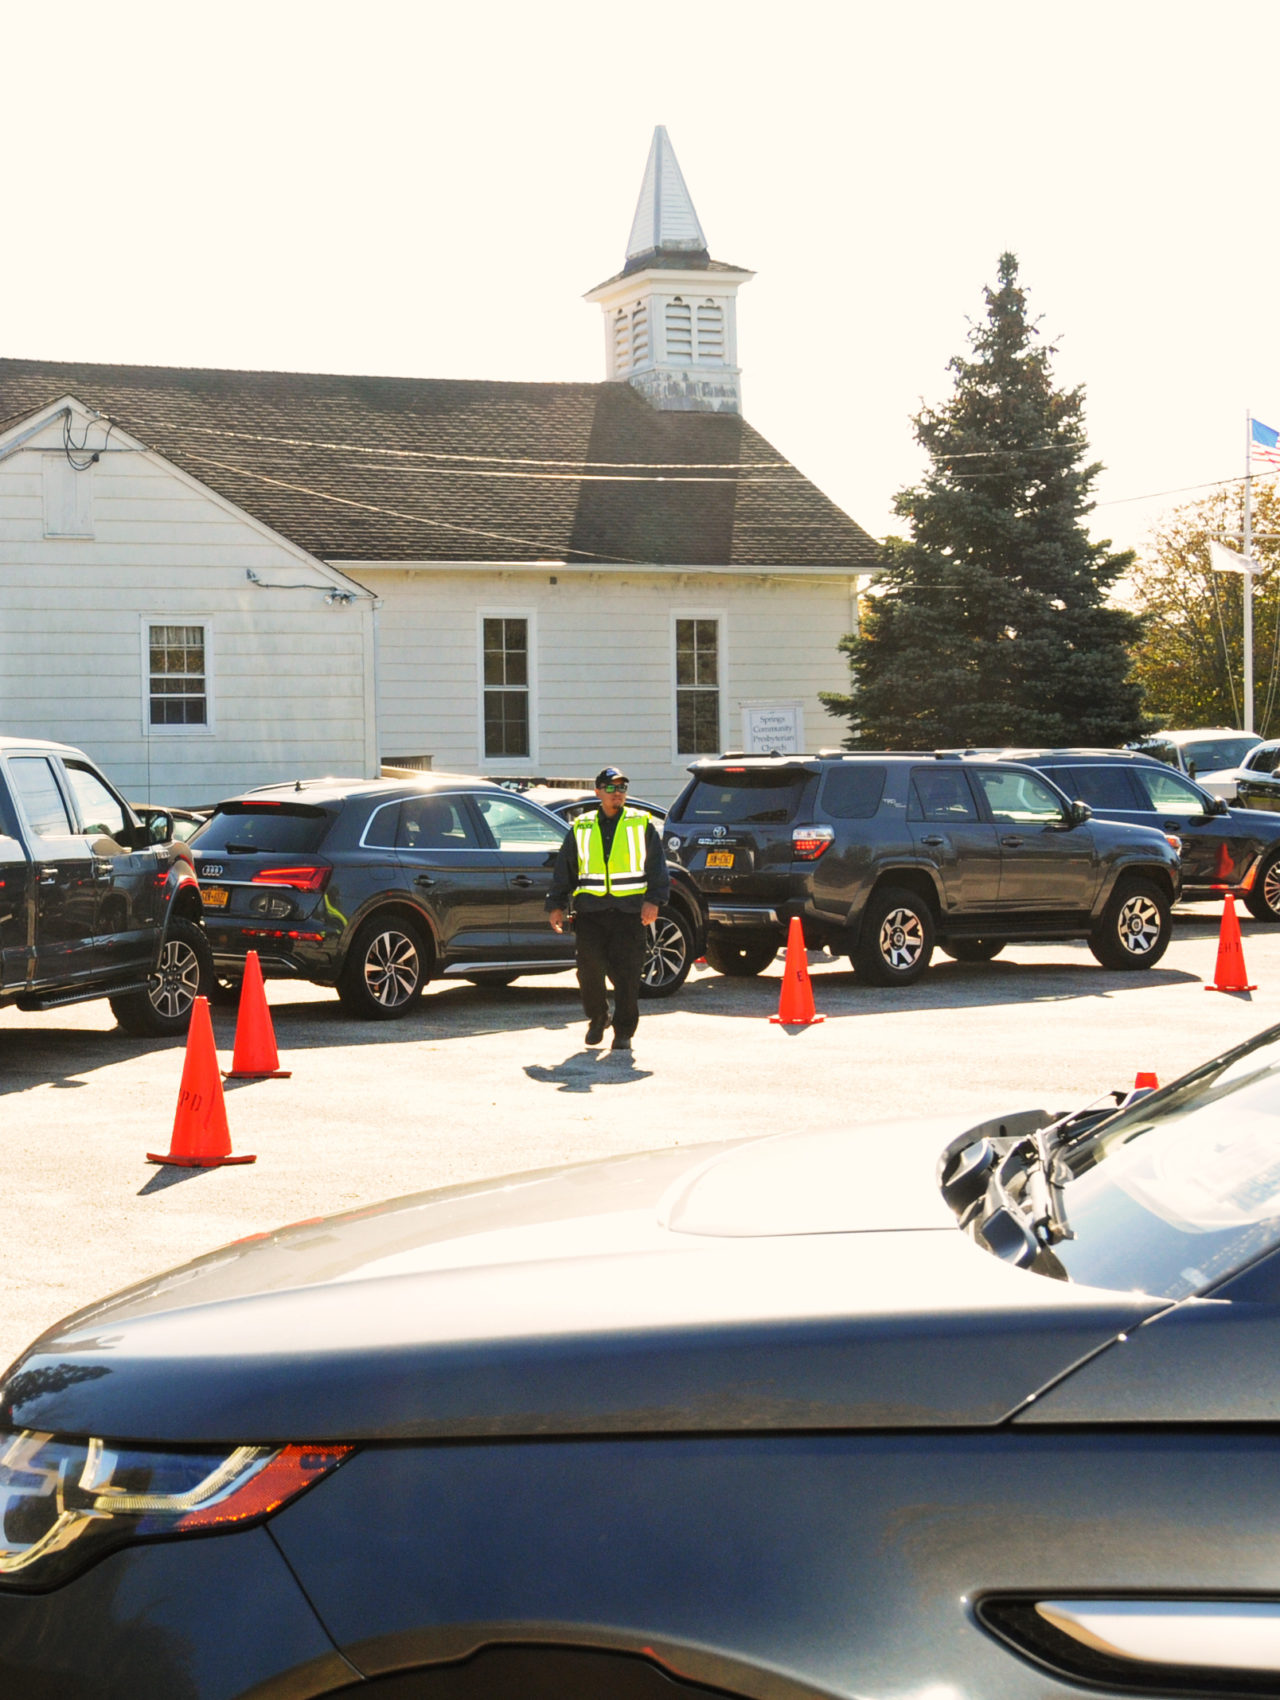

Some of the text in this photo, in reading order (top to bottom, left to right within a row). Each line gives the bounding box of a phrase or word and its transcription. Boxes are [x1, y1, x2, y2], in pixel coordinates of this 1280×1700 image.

[760, 716, 785, 725] Springs
[753, 725, 792, 733] Community
[753, 735, 795, 743] Presbyterian
[761, 744, 788, 752] Church
